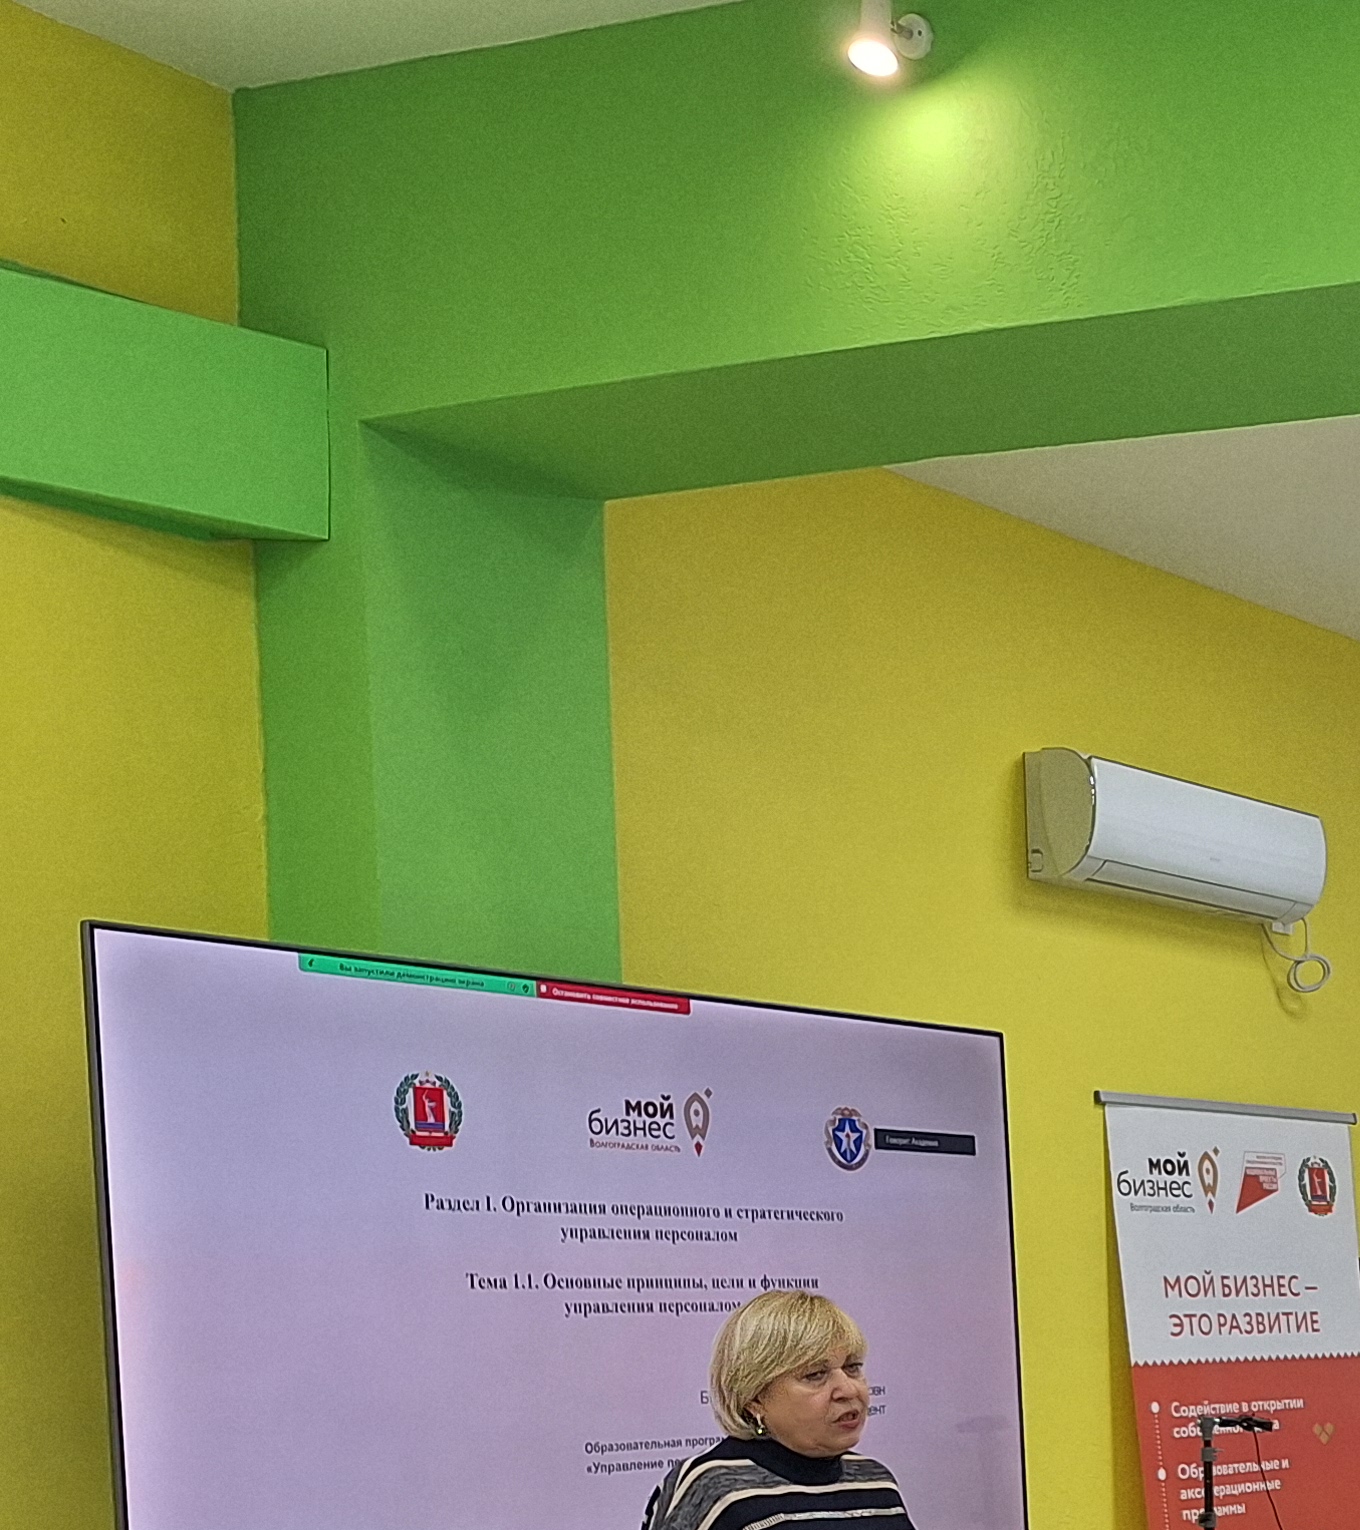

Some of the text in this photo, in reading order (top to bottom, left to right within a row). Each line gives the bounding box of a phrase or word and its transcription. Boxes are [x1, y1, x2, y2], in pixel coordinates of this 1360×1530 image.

[624, 1093, 675, 1120] мой
[588, 1107, 675, 1140] бизнес
[1148, 1151, 1190, 1177] мой
[1117, 1170, 1194, 1198] бизнес
[424, 1193, 480, 1212] Раздел
[501, 1195, 606, 1216] Организация
[611, 1204, 720, 1221] операционного
[724, 1208, 733, 1218] и
[736, 1207, 844, 1223] стратегического
[560, 1226, 738, 1245] управления персоналом
[466, 1272, 819, 1293] Тема 1.1. Основные принципы, цели и функции
[1163, 1270, 1217, 1299] МОЙ
[1221, 1274, 1301, 1298] БИЗНЕС
[564, 1301, 654, 1317] управления
[1169, 1310, 1321, 1338] ЭТО РАЗВИТИЕ
[1171, 1398, 1304, 1418] Содействие в открытии
[584, 1439, 682, 1456] Образовательная
[586, 1459, 664, 1476] «Управление
[1281, 1458, 1289, 1469] и
